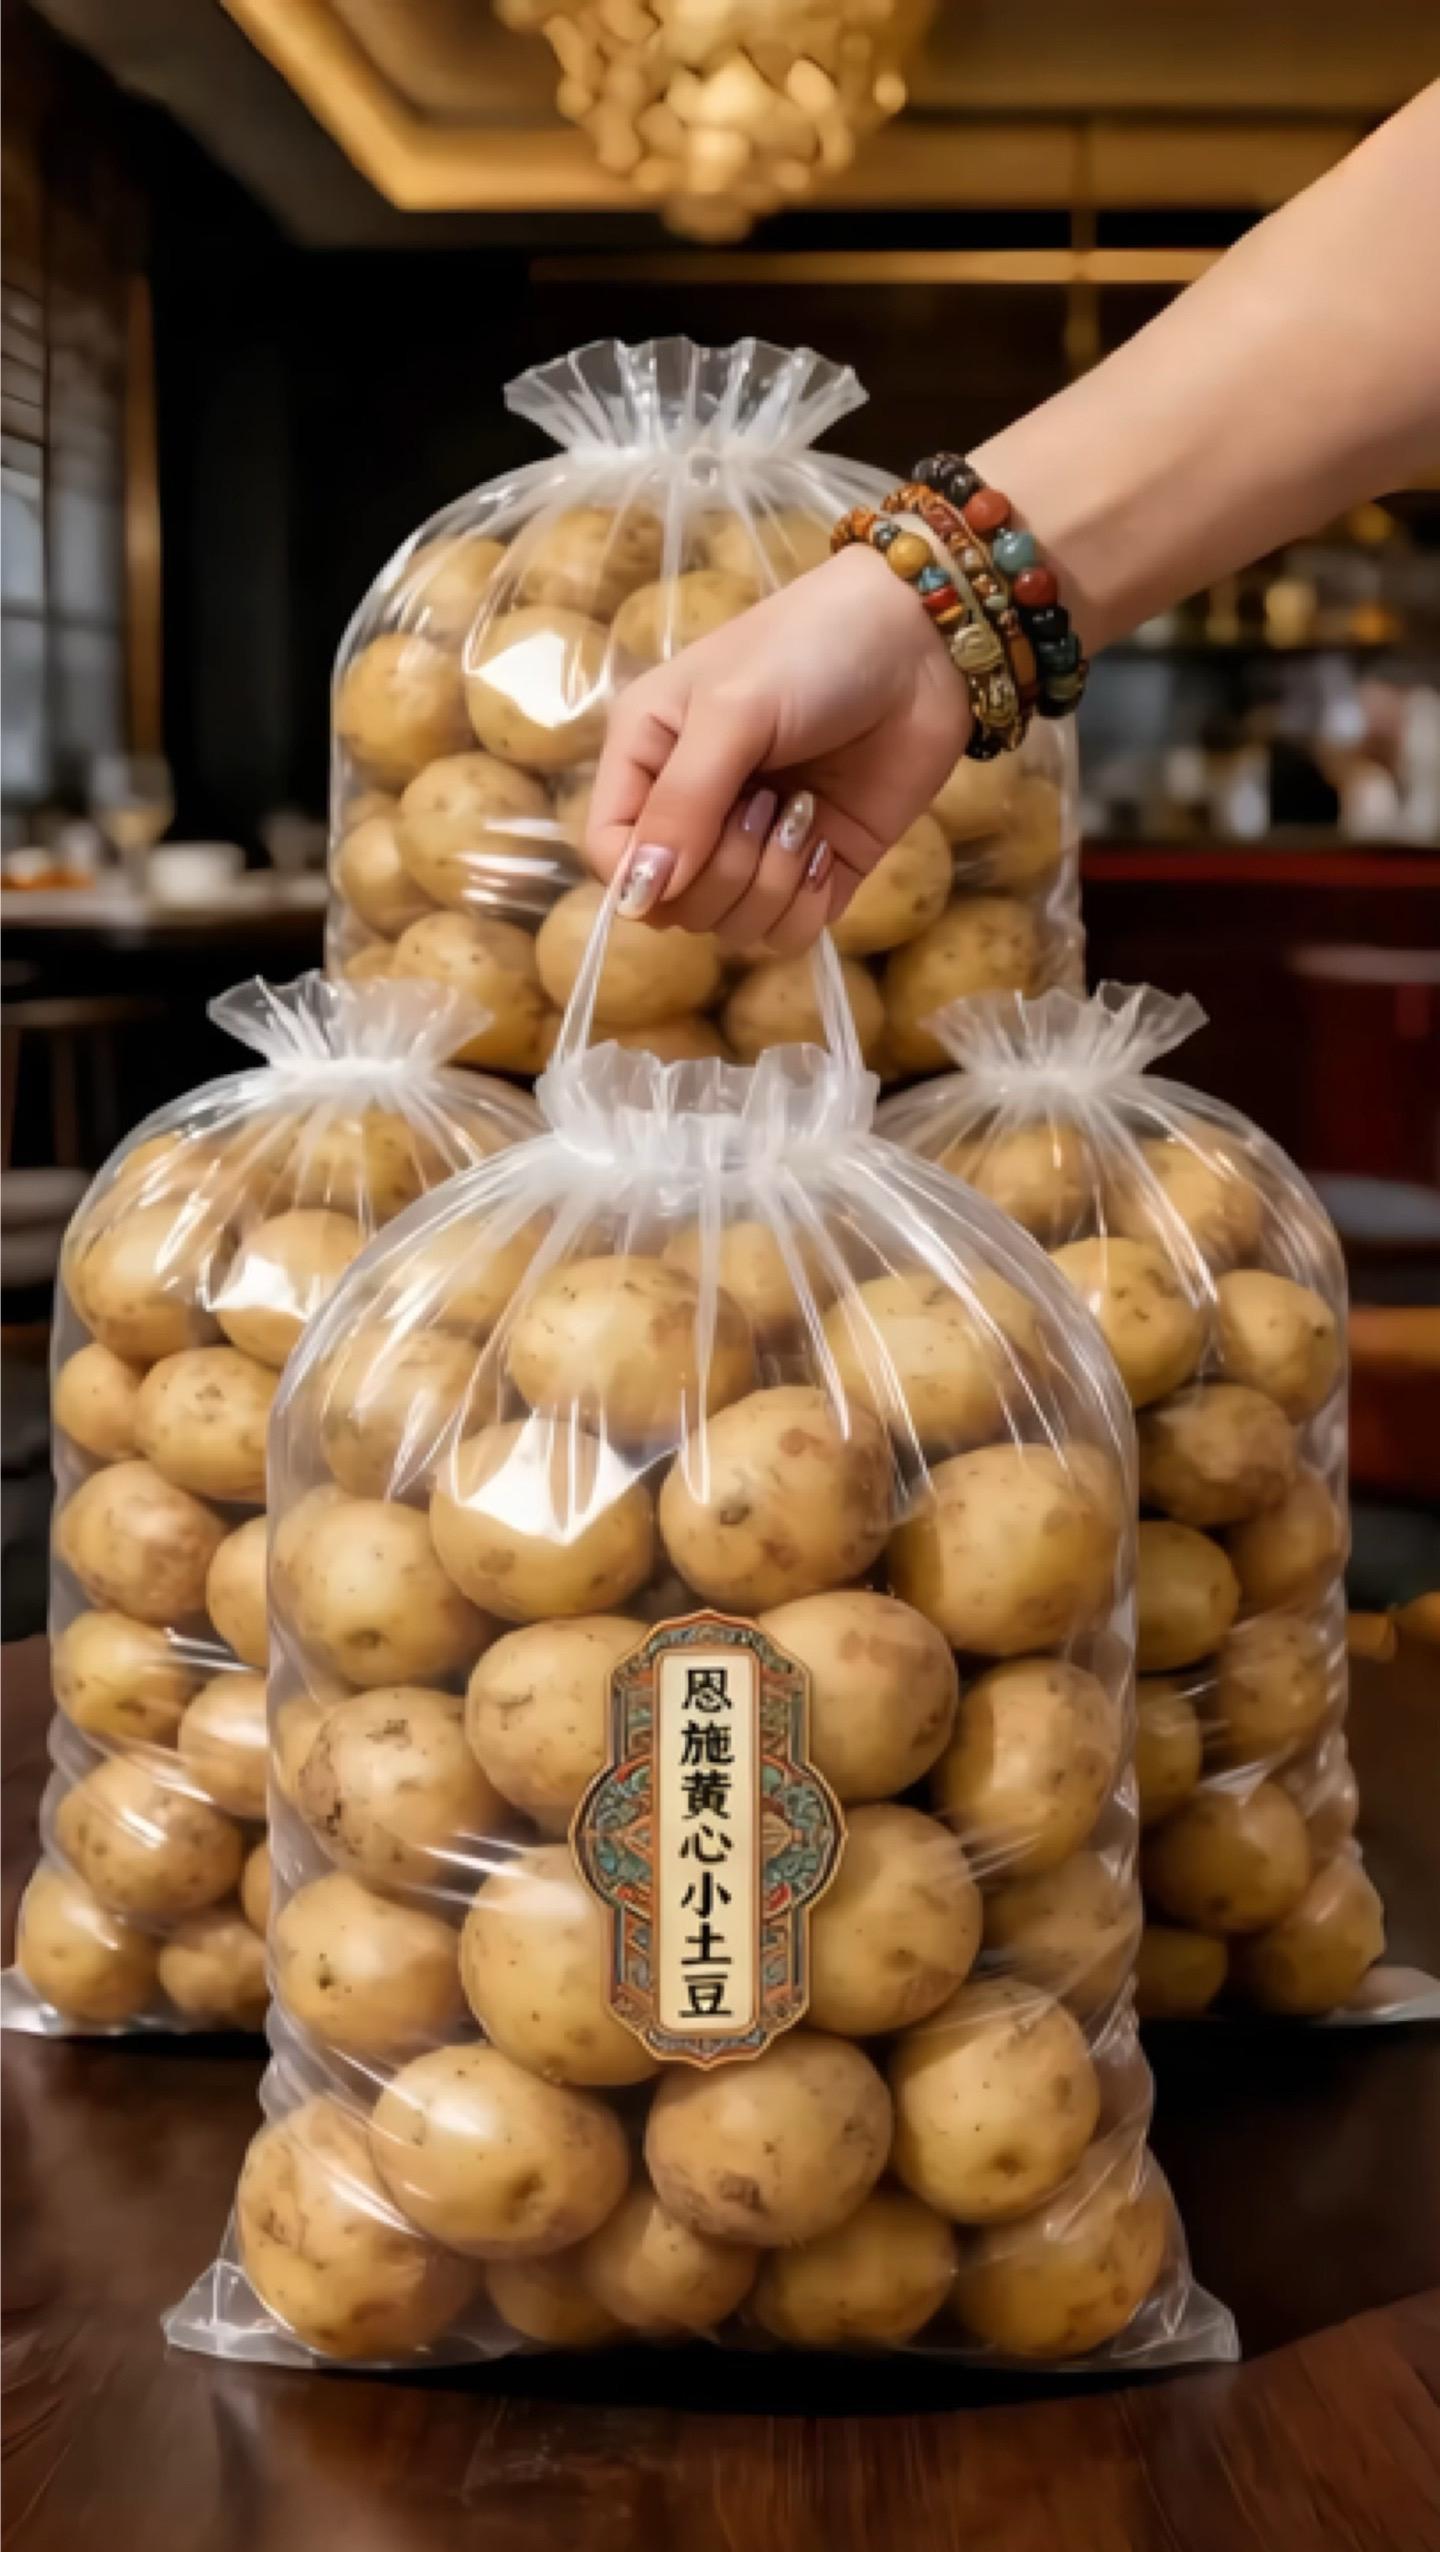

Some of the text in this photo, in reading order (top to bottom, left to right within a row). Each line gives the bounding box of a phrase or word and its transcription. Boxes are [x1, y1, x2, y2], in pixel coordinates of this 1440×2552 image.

[678, 1668, 735, 2018] 恩施黄心小土豆
